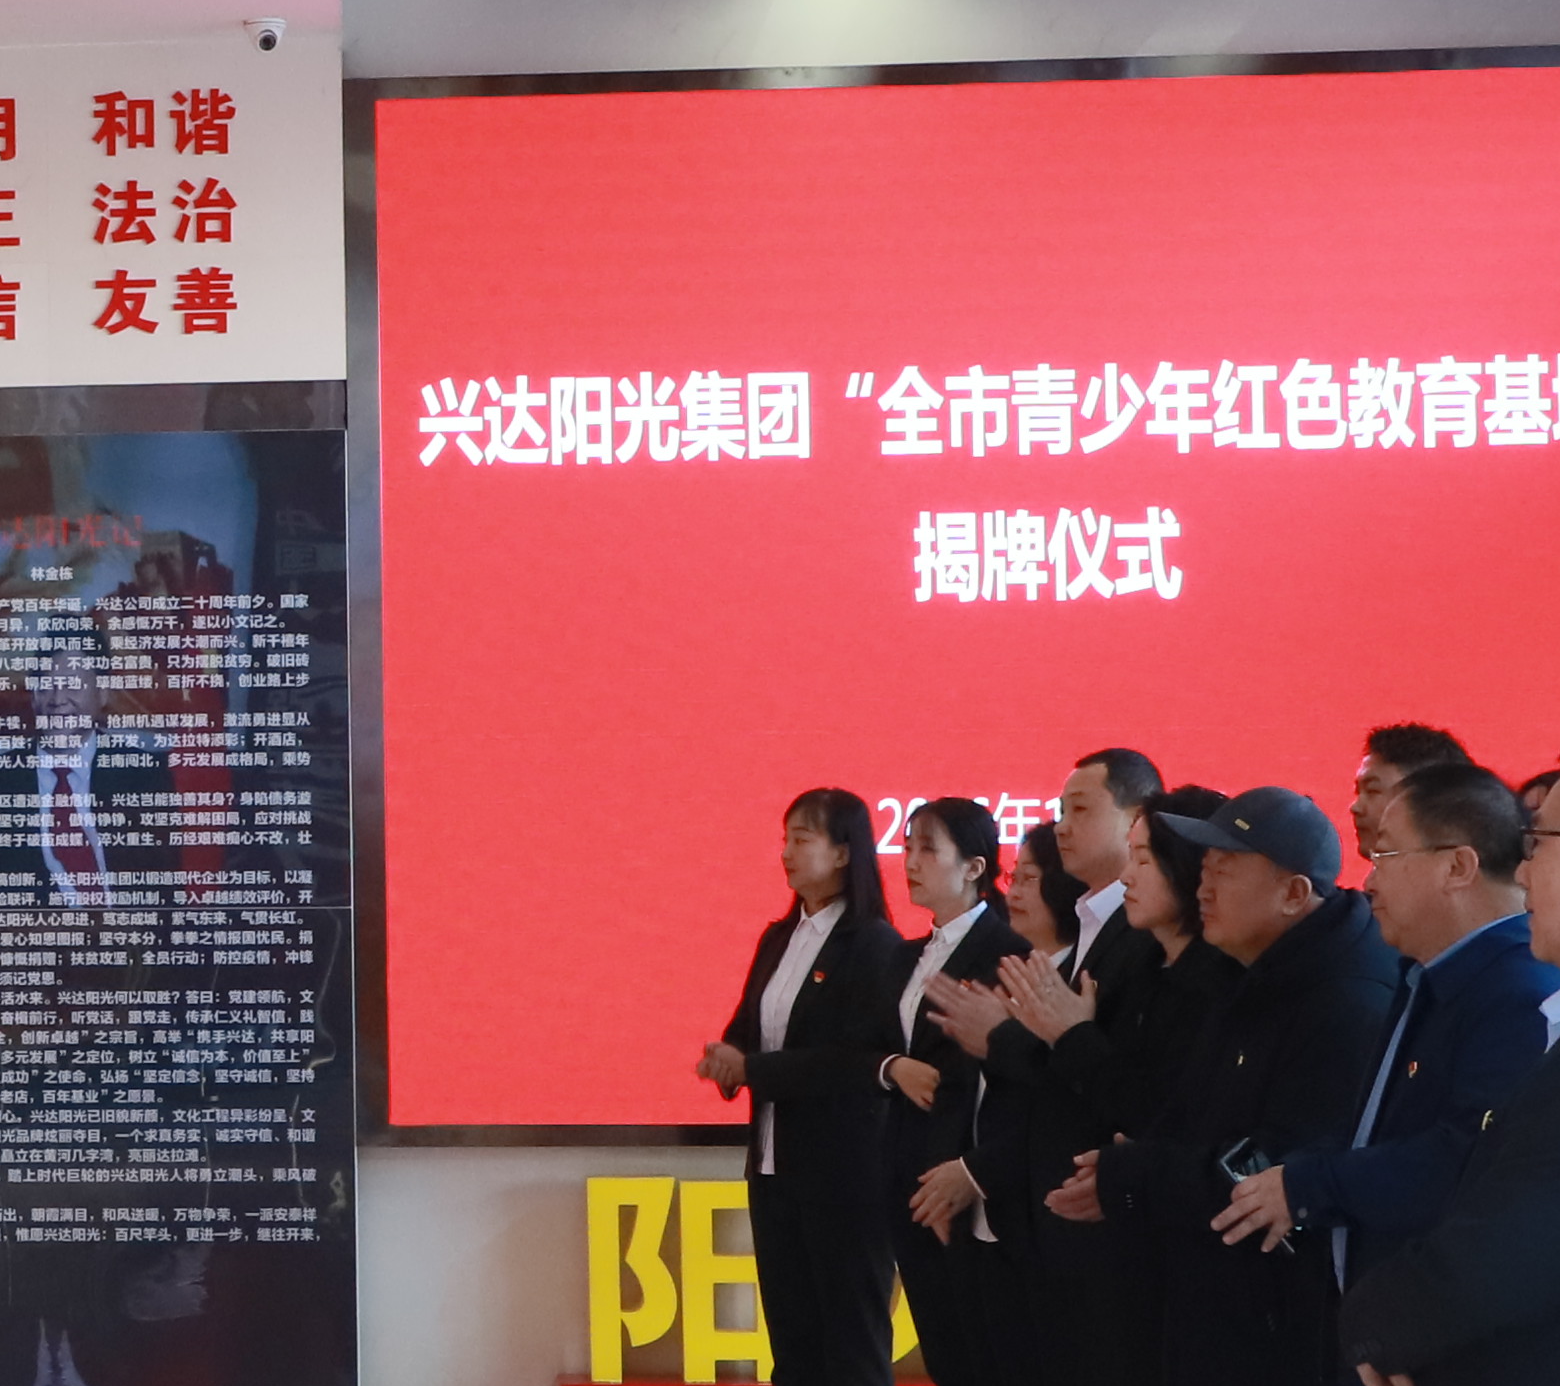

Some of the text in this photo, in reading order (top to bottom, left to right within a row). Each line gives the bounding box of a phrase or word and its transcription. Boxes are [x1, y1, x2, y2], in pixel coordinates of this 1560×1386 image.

[91, 88, 236, 160] 和谐
[91, 179, 236, 248] 法治
[92, 266, 237, 337] 友善
[30, 566, 74, 581] 林金栋
[913, 508, 1182, 603] 揭牌仪式
